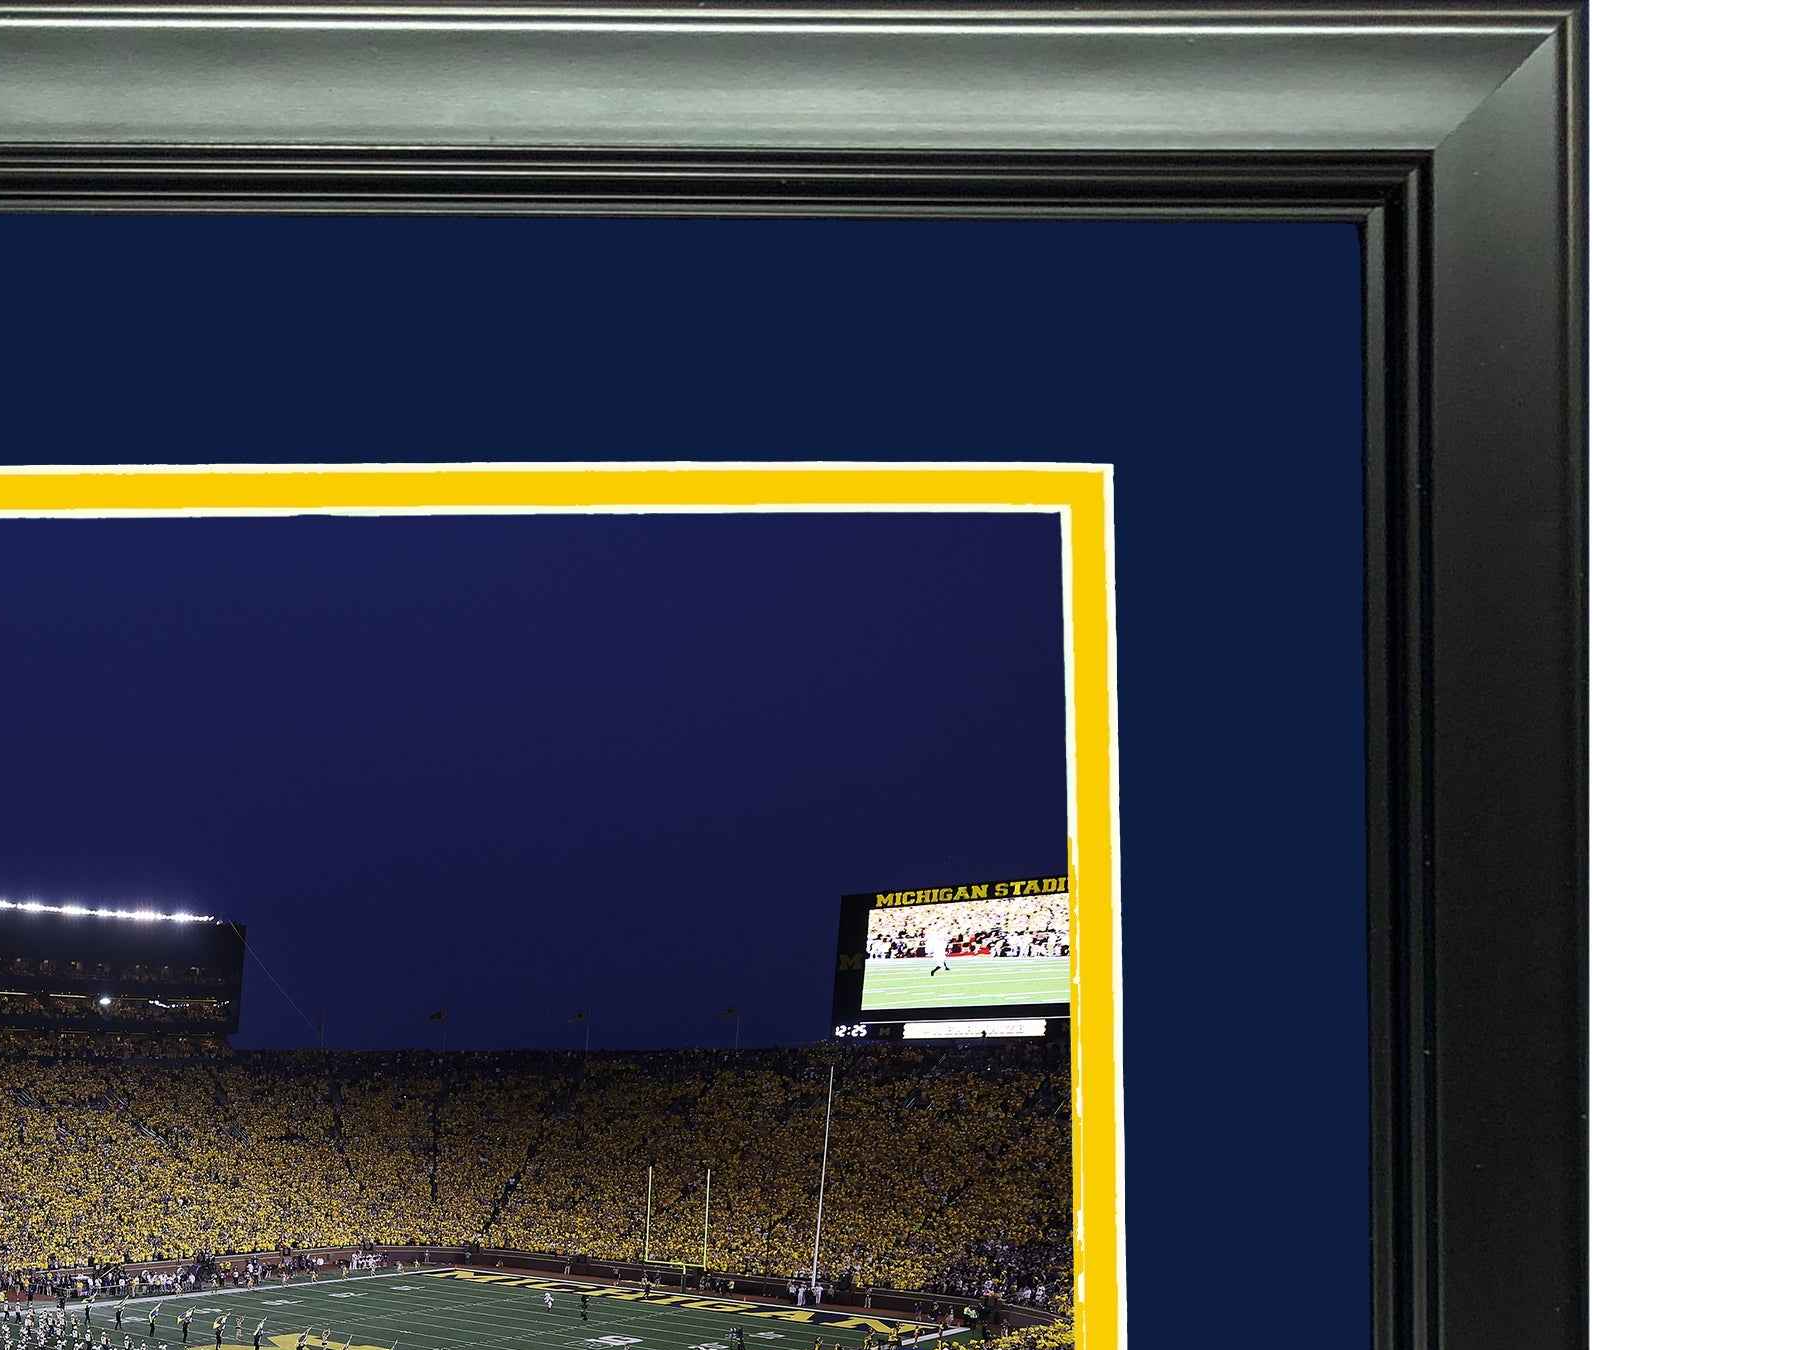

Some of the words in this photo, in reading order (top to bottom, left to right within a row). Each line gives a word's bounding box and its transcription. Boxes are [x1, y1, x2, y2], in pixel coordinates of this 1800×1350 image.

[876, 884, 989, 907] MICHIGAN
[835, 1025, 868, 1038] 12:25
[423, 1269, 940, 1333] MICHIGAN
